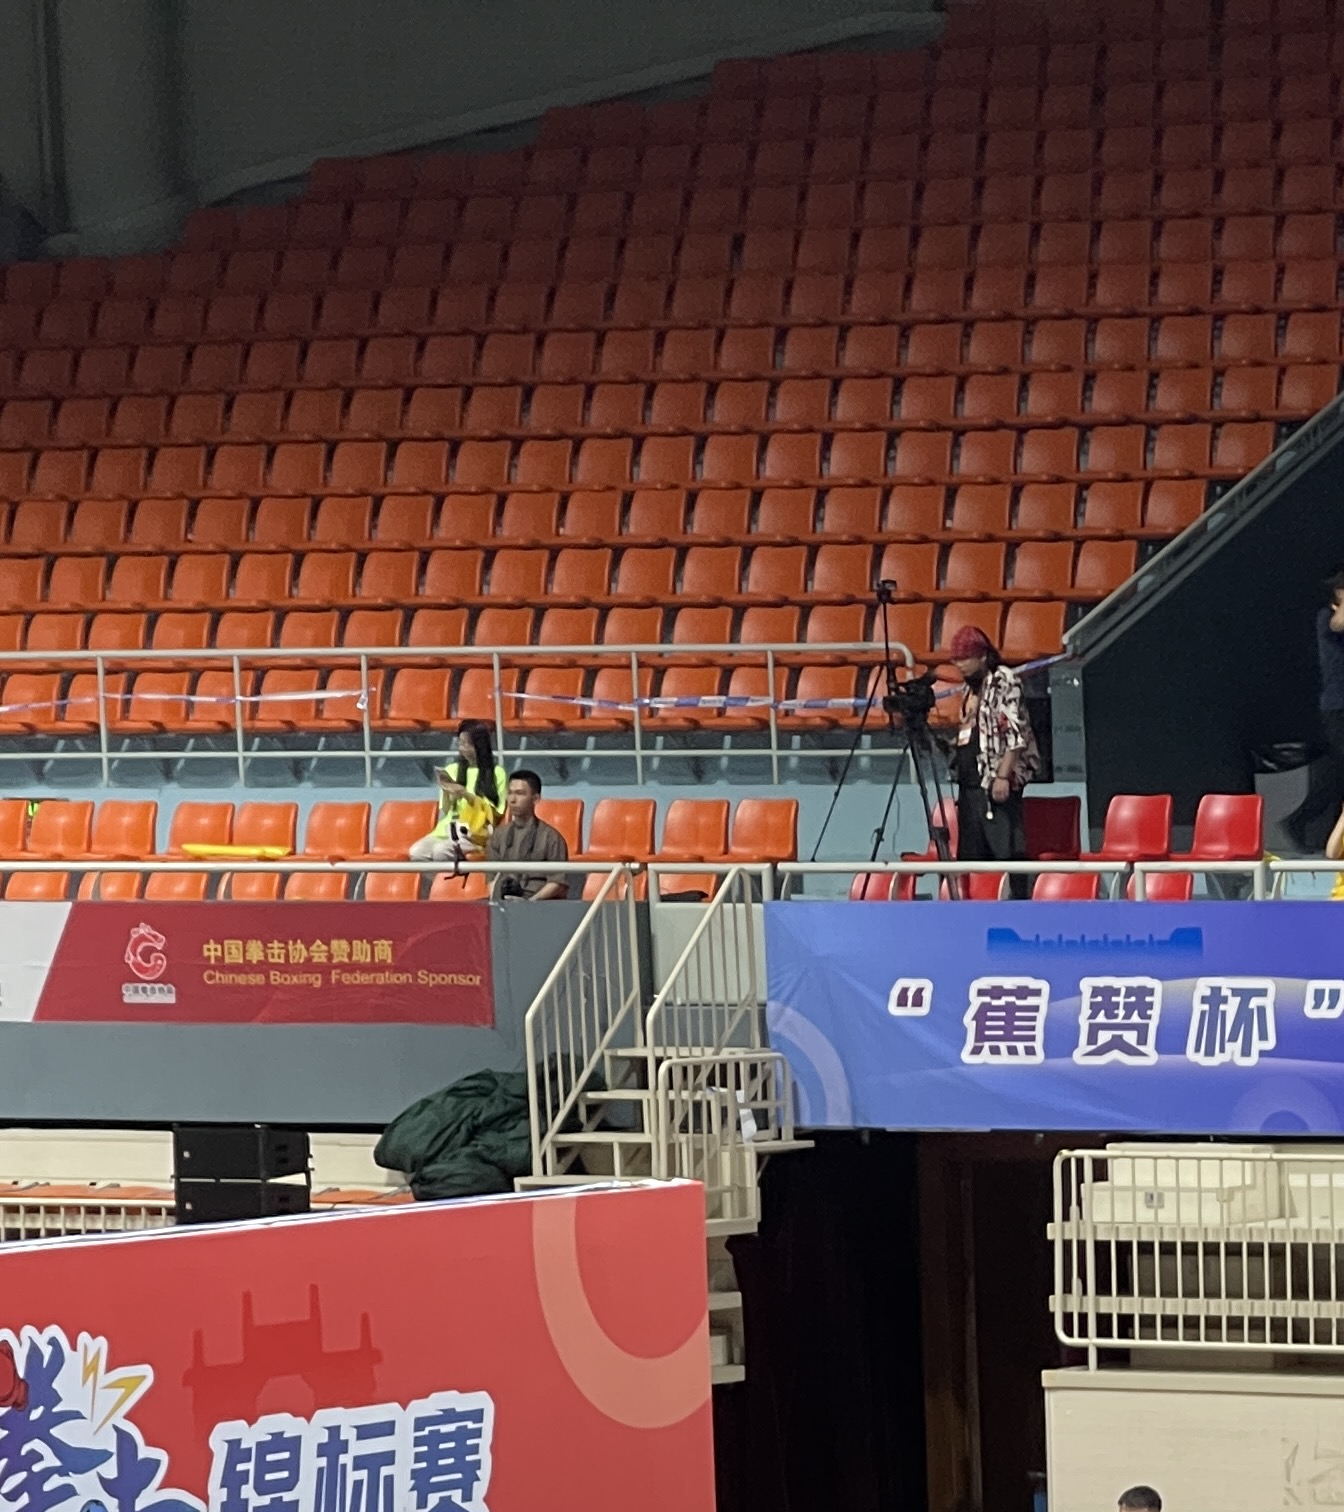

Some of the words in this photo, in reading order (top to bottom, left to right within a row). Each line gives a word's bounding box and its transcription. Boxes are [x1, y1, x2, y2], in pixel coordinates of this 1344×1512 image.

[202, 939, 394, 966] 中国拳击协会赞助商
[203, 969, 266, 987] Chinese
[269, 969, 322, 989] Boxing
[331, 968, 412, 987] Federation
[417, 969, 482, 990] Sponsor
